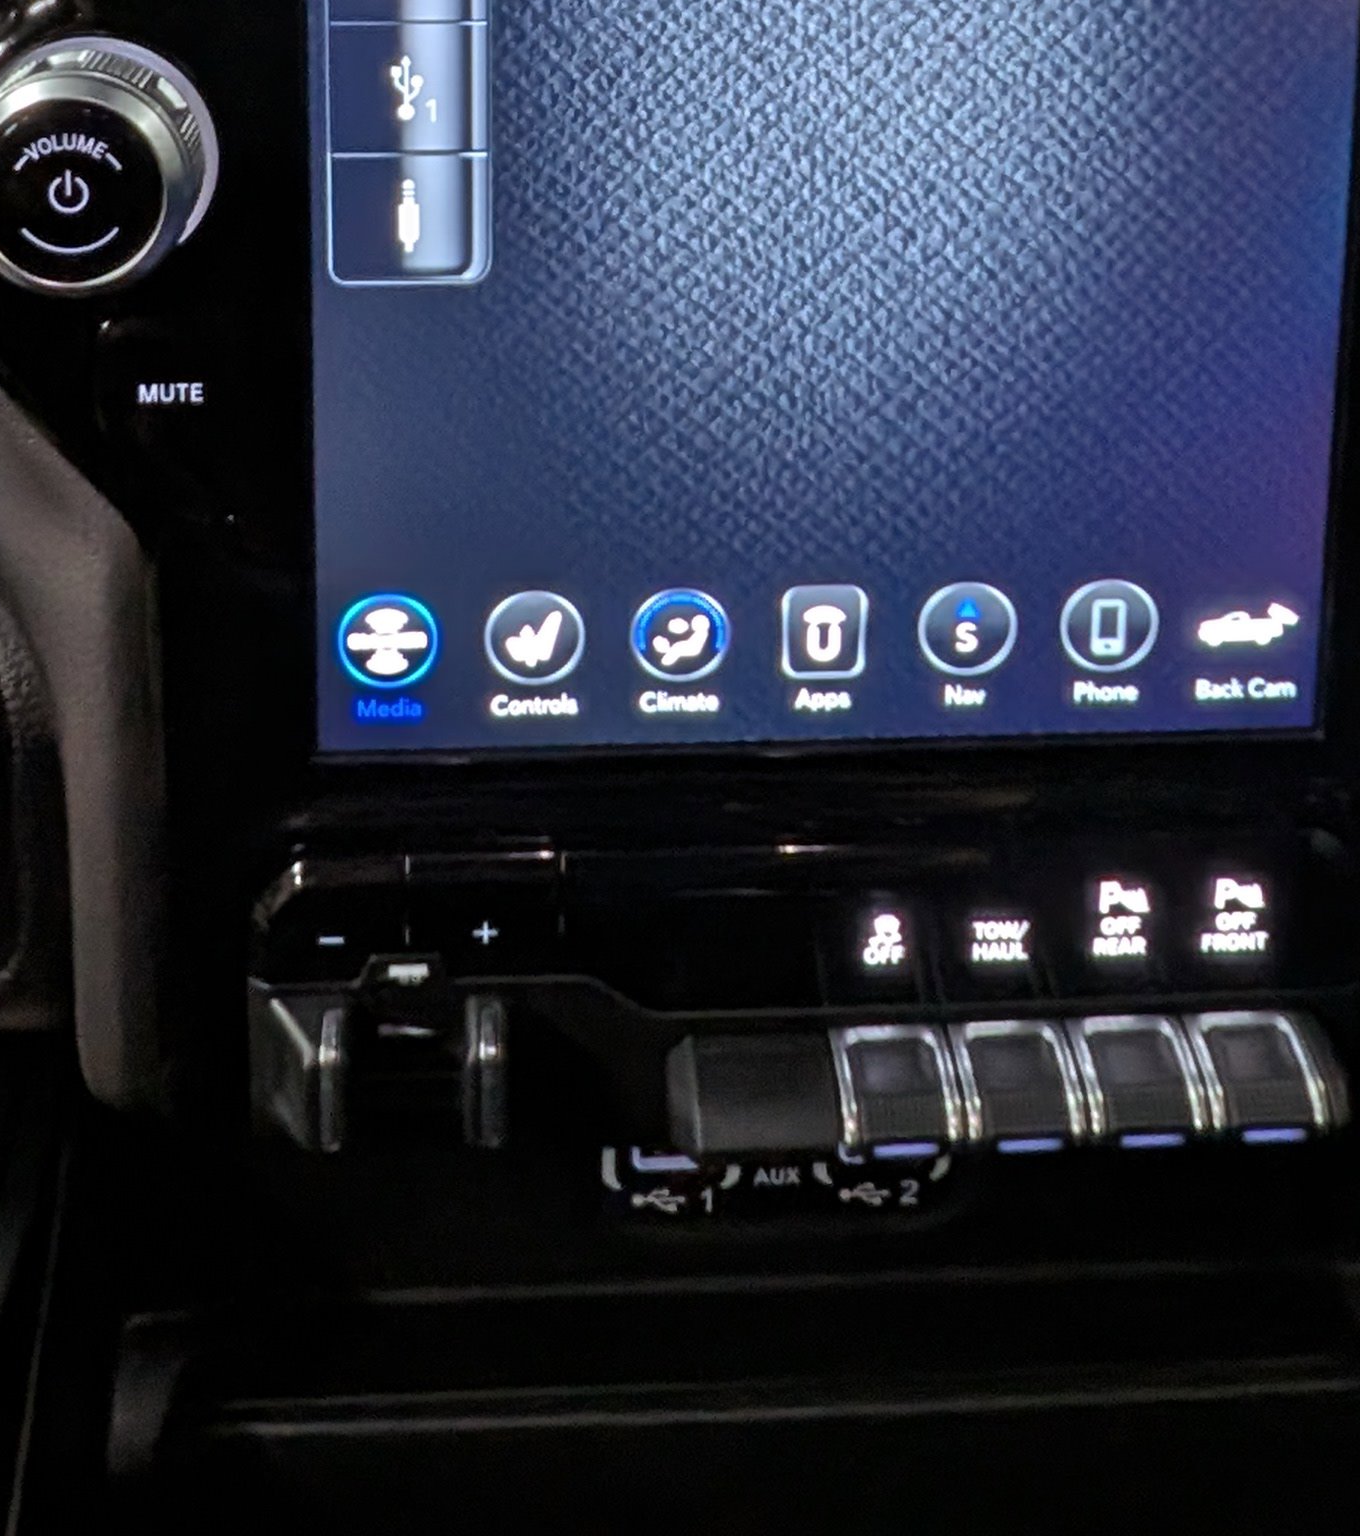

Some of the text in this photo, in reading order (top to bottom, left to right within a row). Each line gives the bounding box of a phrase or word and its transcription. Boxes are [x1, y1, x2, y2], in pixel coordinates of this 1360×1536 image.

[24, 132, 110, 161] VOLUME
[137, 382, 205, 404] MUTE
[794, 686, 852, 711] Apps
[944, 684, 987, 707] Nav
[1073, 681, 1140, 704] Phone
[1194, 677, 1298, 701] Back Cam
[356, 698, 423, 719] Media
[490, 693, 580, 717] Controls
[638, 690, 720, 713] Climate
[971, 919, 1031, 941] TOW/
[1099, 915, 1142, 936] OFF
[1214, 911, 1258, 932] OFF
[972, 941, 1029, 962] HAUL
[1092, 936, 1148, 957] REAR
[1200, 931, 1270, 953] FRONT
[863, 944, 906, 965] OFF
[753, 1167, 802, 1187] AUX
[700, 1187, 714, 1213] 1
[899, 1178, 920, 1206] 2
